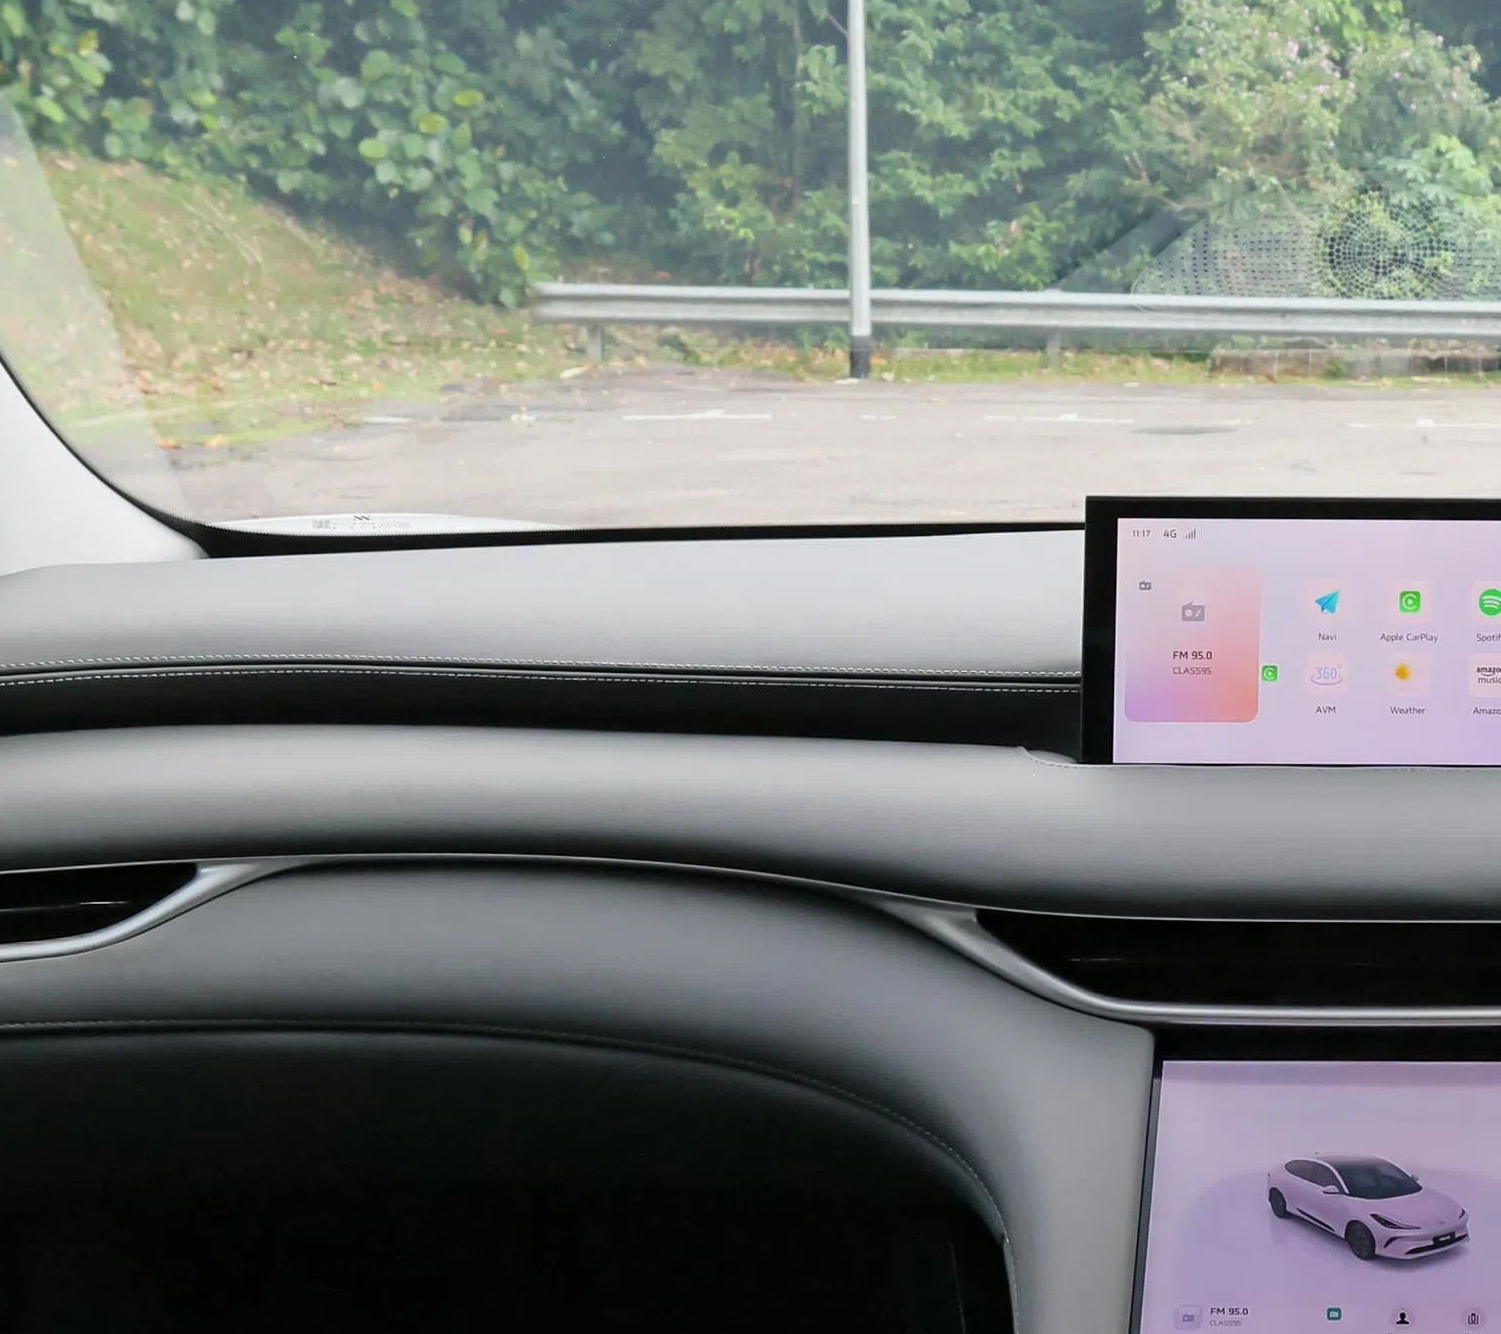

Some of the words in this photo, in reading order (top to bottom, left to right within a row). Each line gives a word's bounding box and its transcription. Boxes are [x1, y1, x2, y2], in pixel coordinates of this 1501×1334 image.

[1163, 529, 1177, 539] 4G
[1318, 633, 1337, 641] Navi
[1379, 633, 1404, 643] Apple
[1406, 633, 1439, 643] CarPlay
[1172, 650, 1189, 660] FM
[1191, 650, 1213, 660] 95.0
[1477, 676, 1501, 684] music
[1316, 706, 1337, 714] AVM
[1390, 706, 1426, 715] Weather
[1210, 1307, 1226, 1316] FM
[1229, 1307, 1249, 1316] 95.0
